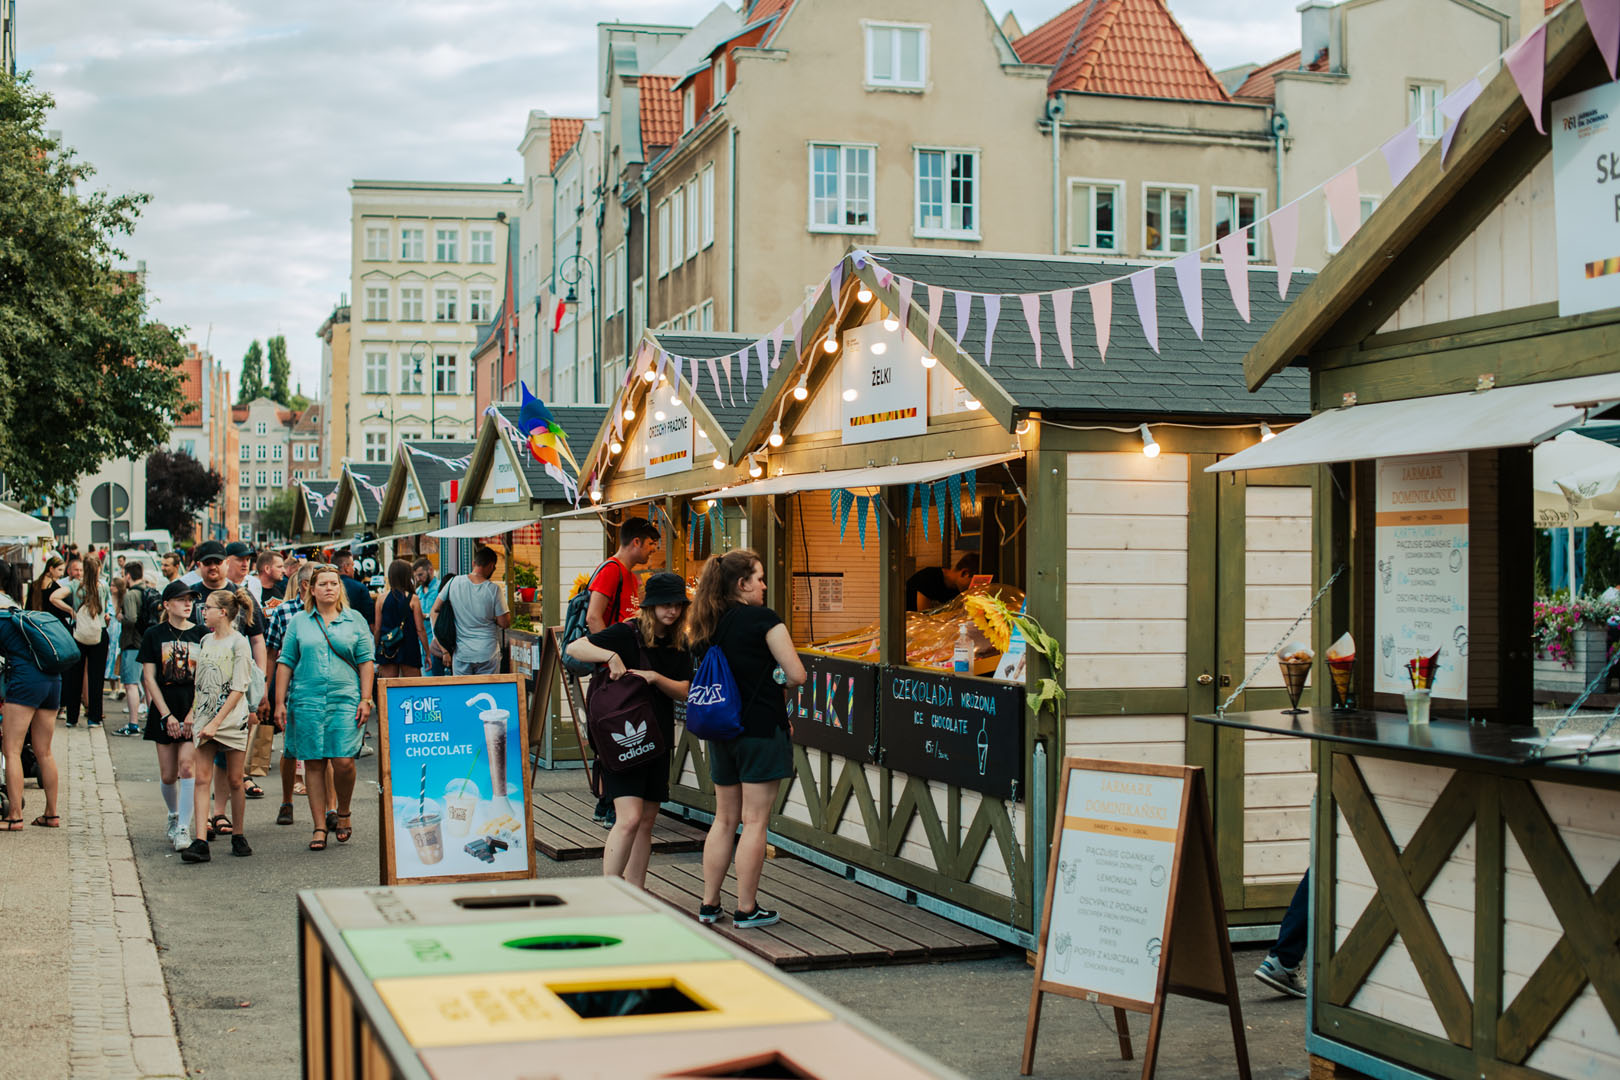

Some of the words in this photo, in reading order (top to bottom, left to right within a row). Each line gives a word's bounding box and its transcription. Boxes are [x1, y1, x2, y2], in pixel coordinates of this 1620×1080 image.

[872, 365, 892, 386] ŻELKI
[414, 696, 441, 713] ONE
[893, 678, 953, 707] CZEKOLADA
[961, 691, 996, 716] MROŻONA
[415, 710, 443, 723] SLUSH
[914, 711, 924, 725] ICE
[931, 714, 968, 735] CHOCOLATE
[405, 731, 450, 744] FROZEN
[406, 744, 473, 758] CHOCOLATE
[618, 741, 656, 762] adidas
